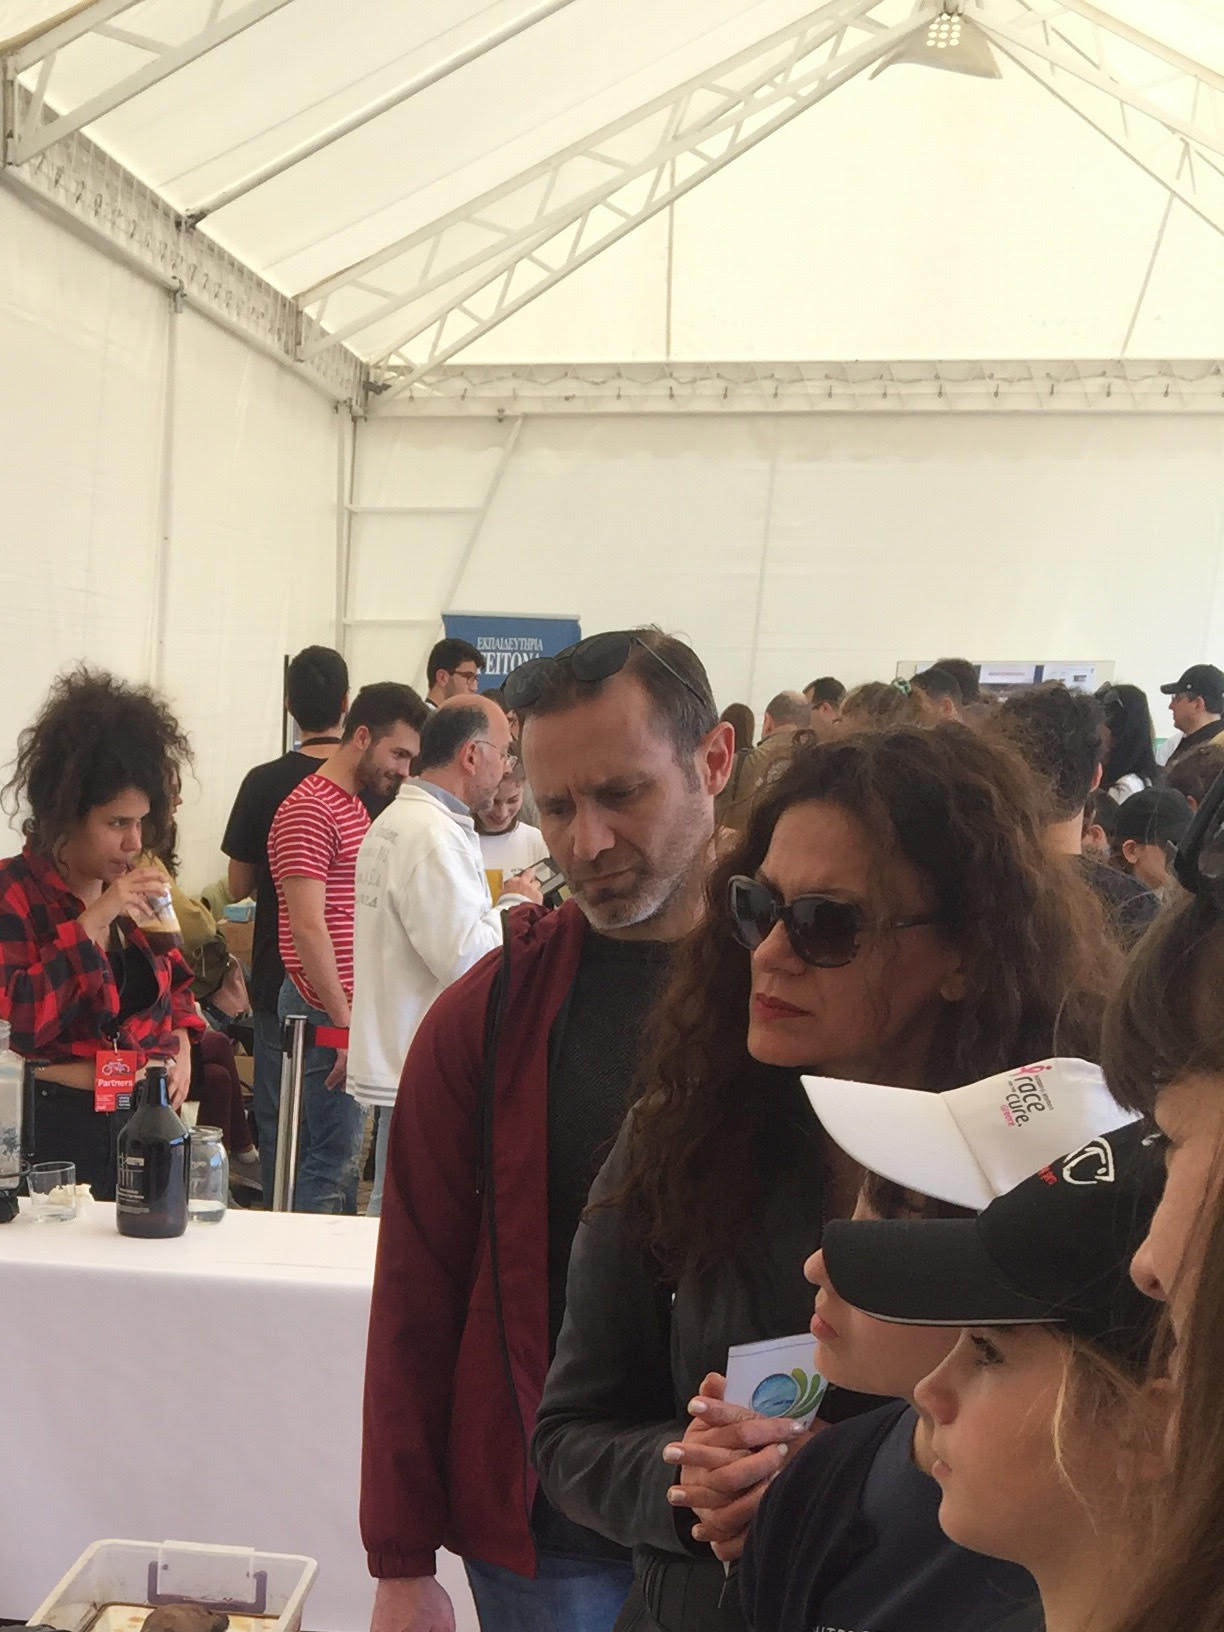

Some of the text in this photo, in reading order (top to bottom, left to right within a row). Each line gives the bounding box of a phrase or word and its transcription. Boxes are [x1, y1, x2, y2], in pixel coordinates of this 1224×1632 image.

[477, 637, 544, 652] ΕΚΠΑΙΔΕΥΤΗΡΙΑ
[477, 652, 540, 675] ΕΙΤΟ
[97, 1079, 133, 1087] Partners
[1014, 1076, 1046, 1113] race
